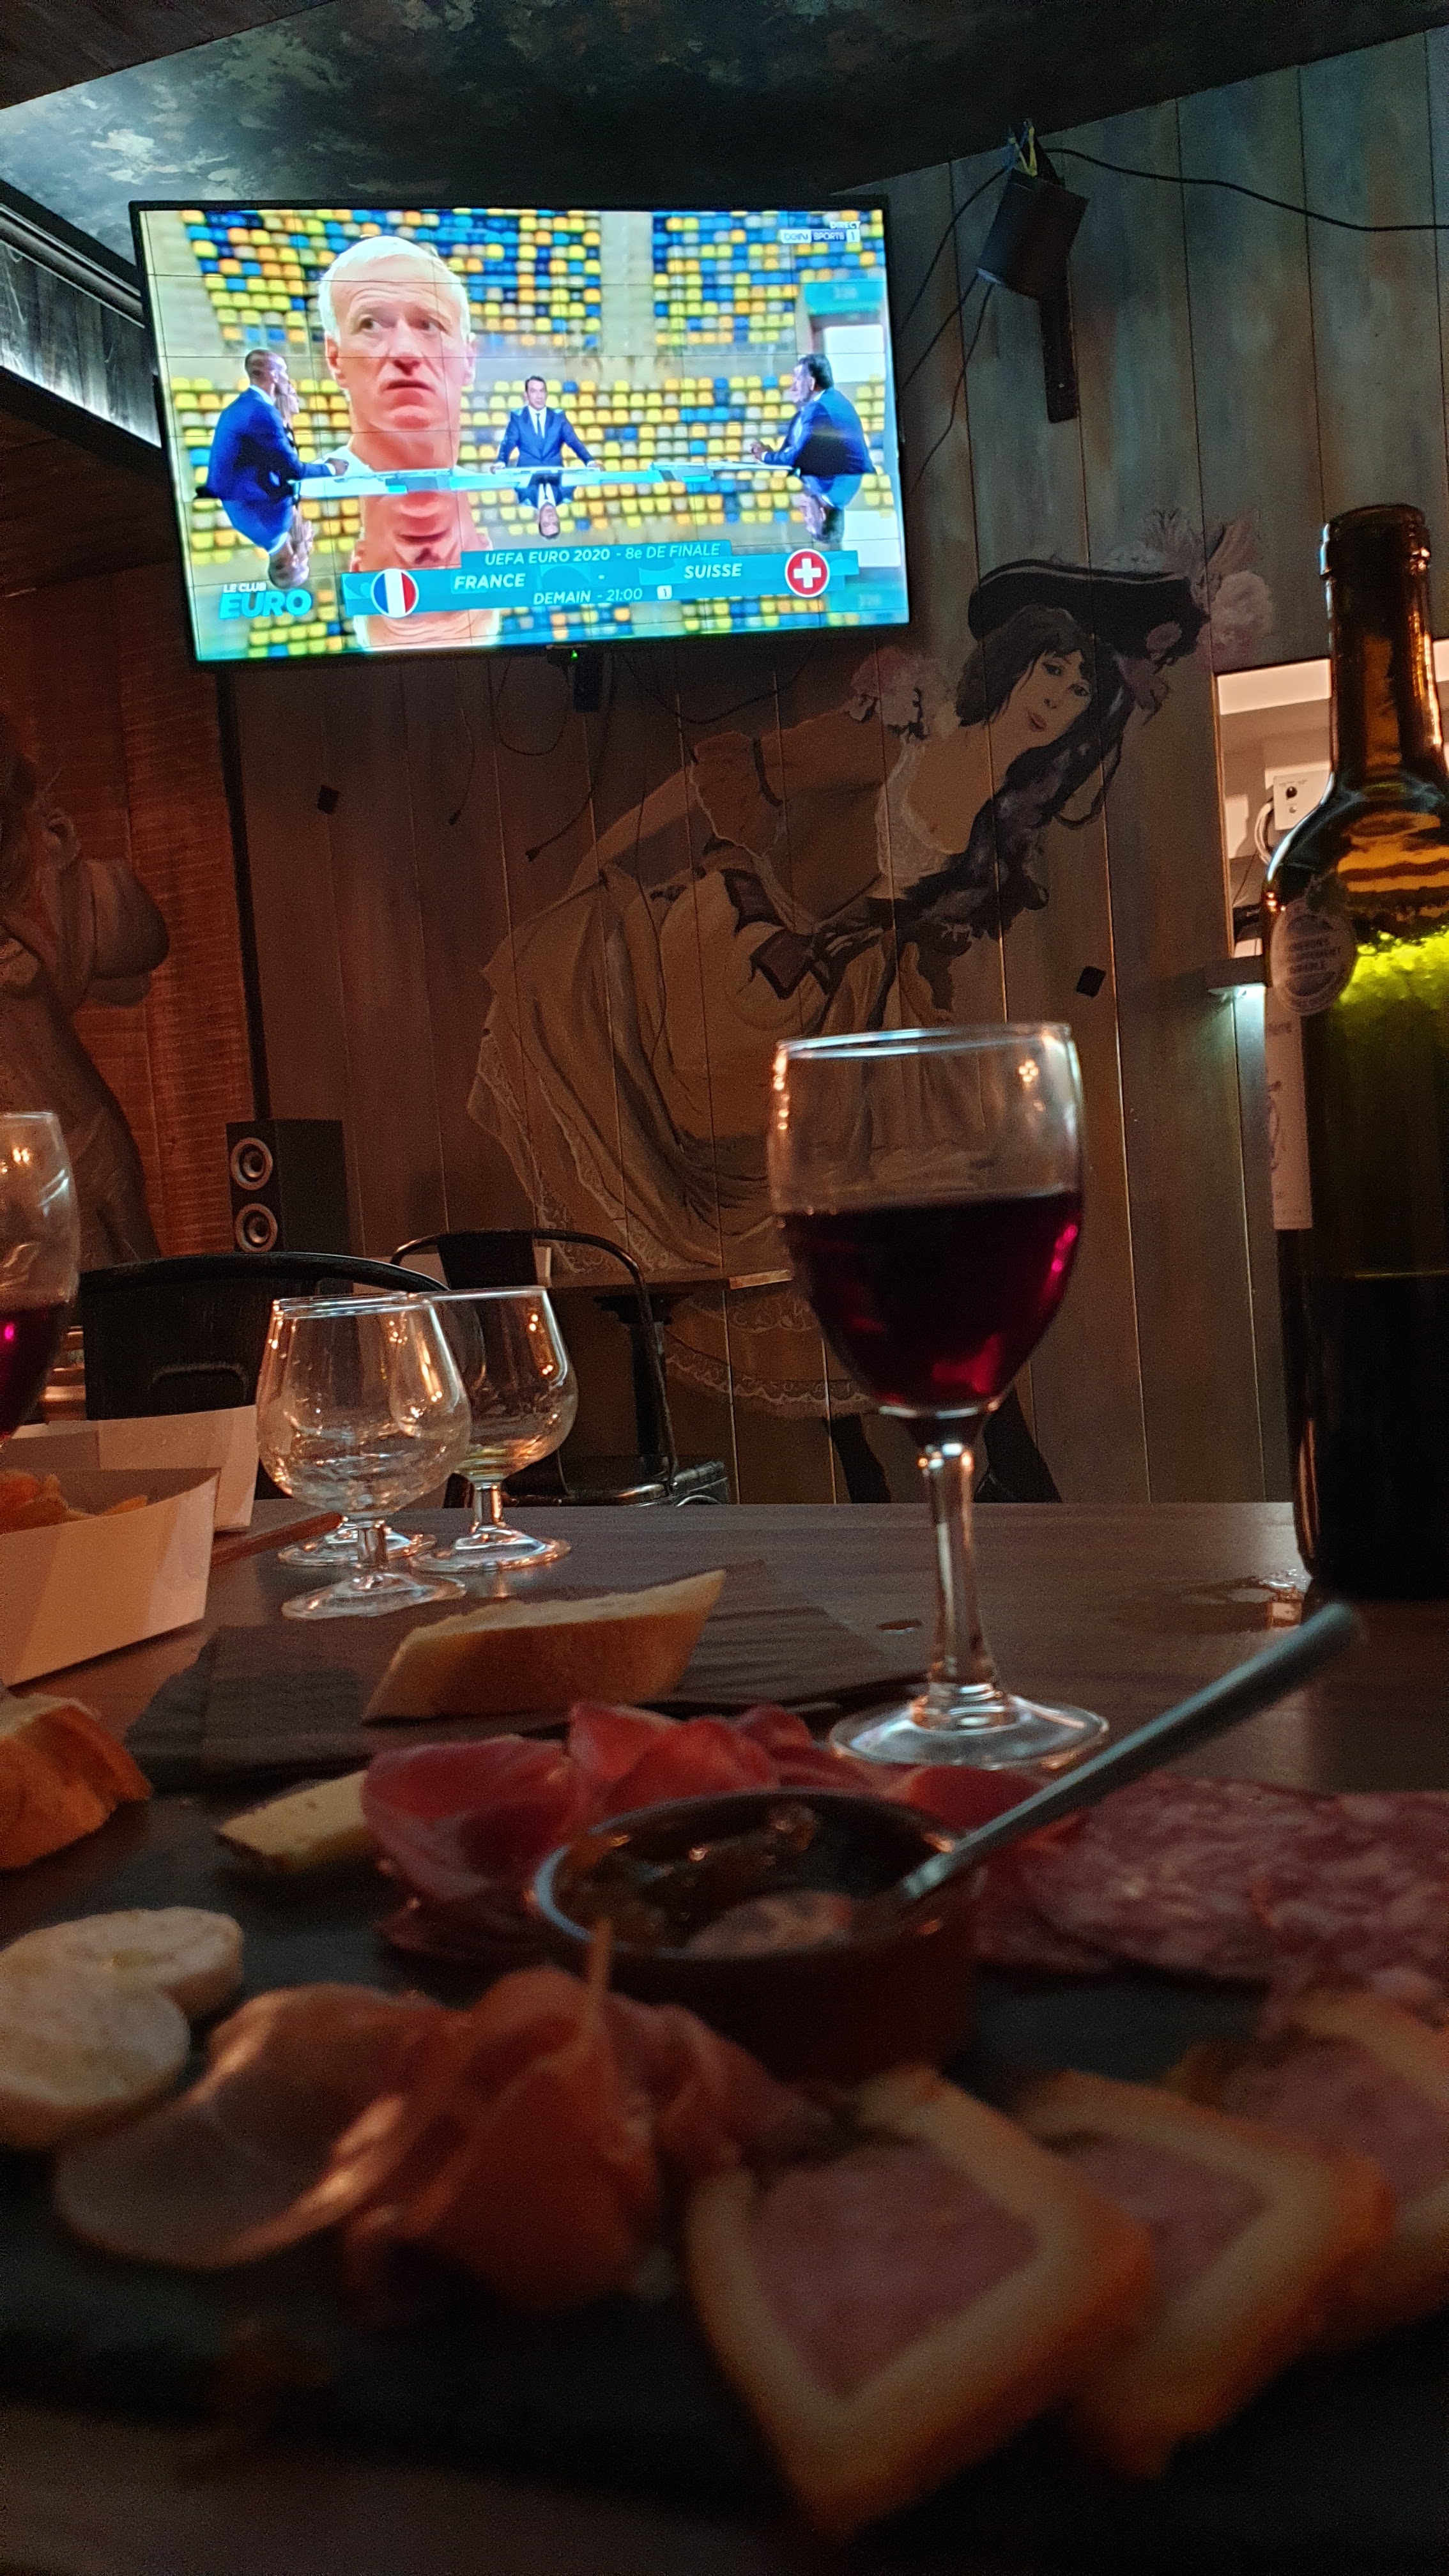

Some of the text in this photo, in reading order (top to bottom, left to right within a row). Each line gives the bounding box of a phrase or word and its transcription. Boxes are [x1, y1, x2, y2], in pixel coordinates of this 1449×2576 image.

[813, 232, 845, 241] SPORTS
[485, 552, 525, 565] UEFA
[528, 550, 570, 564] EURO
[572, 548, 611, 562] 2020
[625, 547, 643, 560] 8e
[646, 546, 666, 558] DE
[669, 543, 721, 558] FINALE
[454, 573, 526, 590] FRANCE
[684, 563, 742, 579] SUISSE
[224, 582, 266, 594] LE CLUB
[533, 590, 592, 605] DEMAIN
[606, 588, 643, 602] 21:00
[219, 588, 312, 620] EURO
